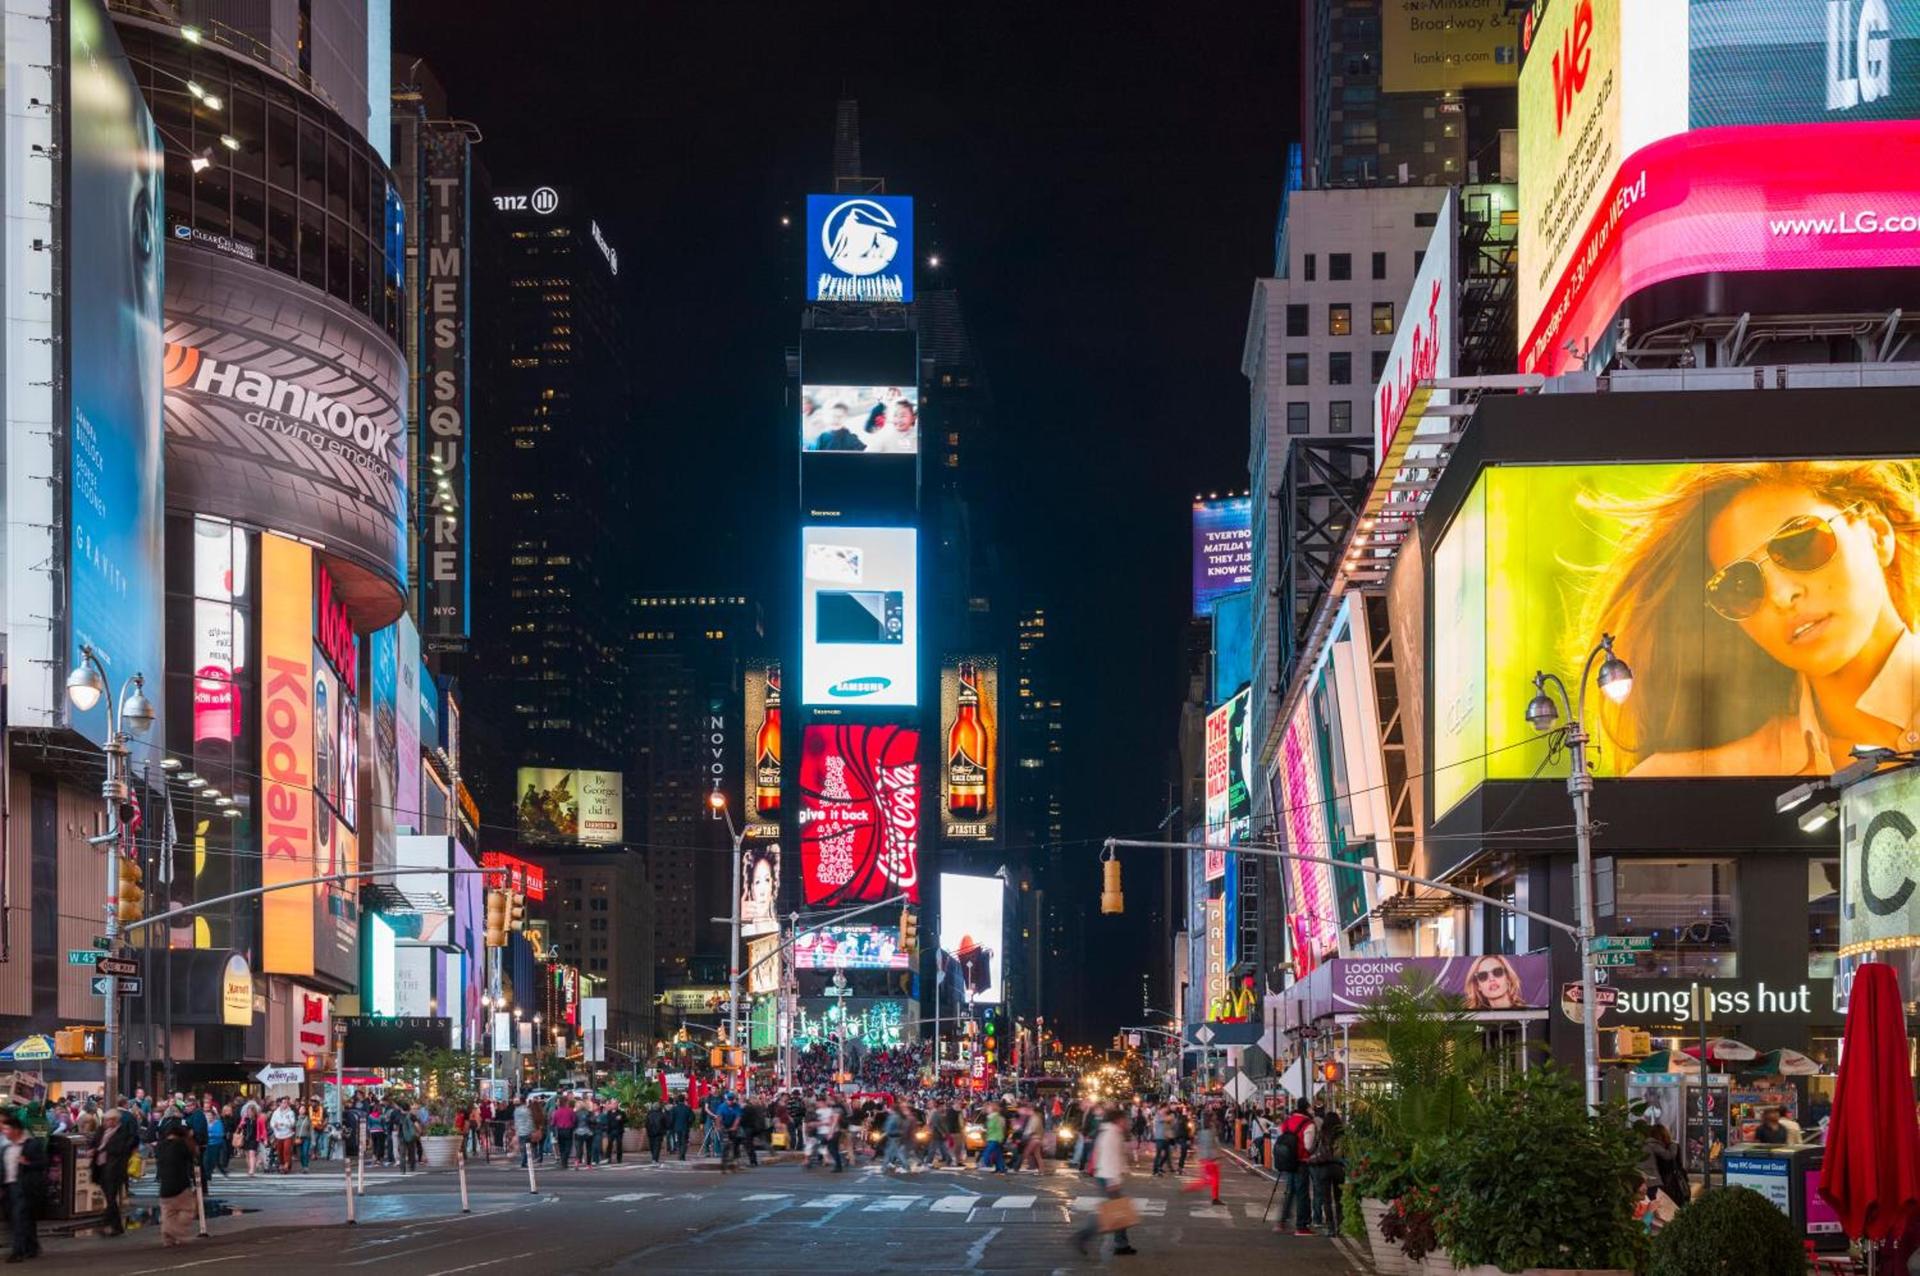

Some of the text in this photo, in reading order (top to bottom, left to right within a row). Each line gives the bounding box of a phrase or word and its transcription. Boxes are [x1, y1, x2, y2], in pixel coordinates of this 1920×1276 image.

[1410, 16, 1485, 32] Broadway
[1826, 0, 1890, 111] LG
[429, 177, 461, 349] TIMES
[245, 410, 325, 450] driving
[429, 369, 463, 582] SQUARE
[1204, 542, 1244, 553] MATILDA
[1209, 554, 1233, 564] THEY
[1208, 565, 1238, 576] KNOW
[433, 606, 456, 616] NYC
[1208, 710, 1228, 742] THE
[266, 655, 308, 862] Kodak
[1208, 752, 1228, 779] GOES
[711, 716, 724, 820] NOVOTL
[588, 805, 602, 815] did
[799, 808, 869, 824] give it back
[69, 952, 96, 964] W 45
[1598, 953, 1608, 965] W
[1612, 953, 1626, 965] 45
[1344, 962, 1404, 974] LOOKING
[1344, 974, 1385, 986] GOOD
[1345, 985, 1375, 997] NEW
[1616, 982, 1750, 1022] sungss
[1757, 982, 1811, 1014] hut
[352, 1019, 445, 1029] MARQUIS
